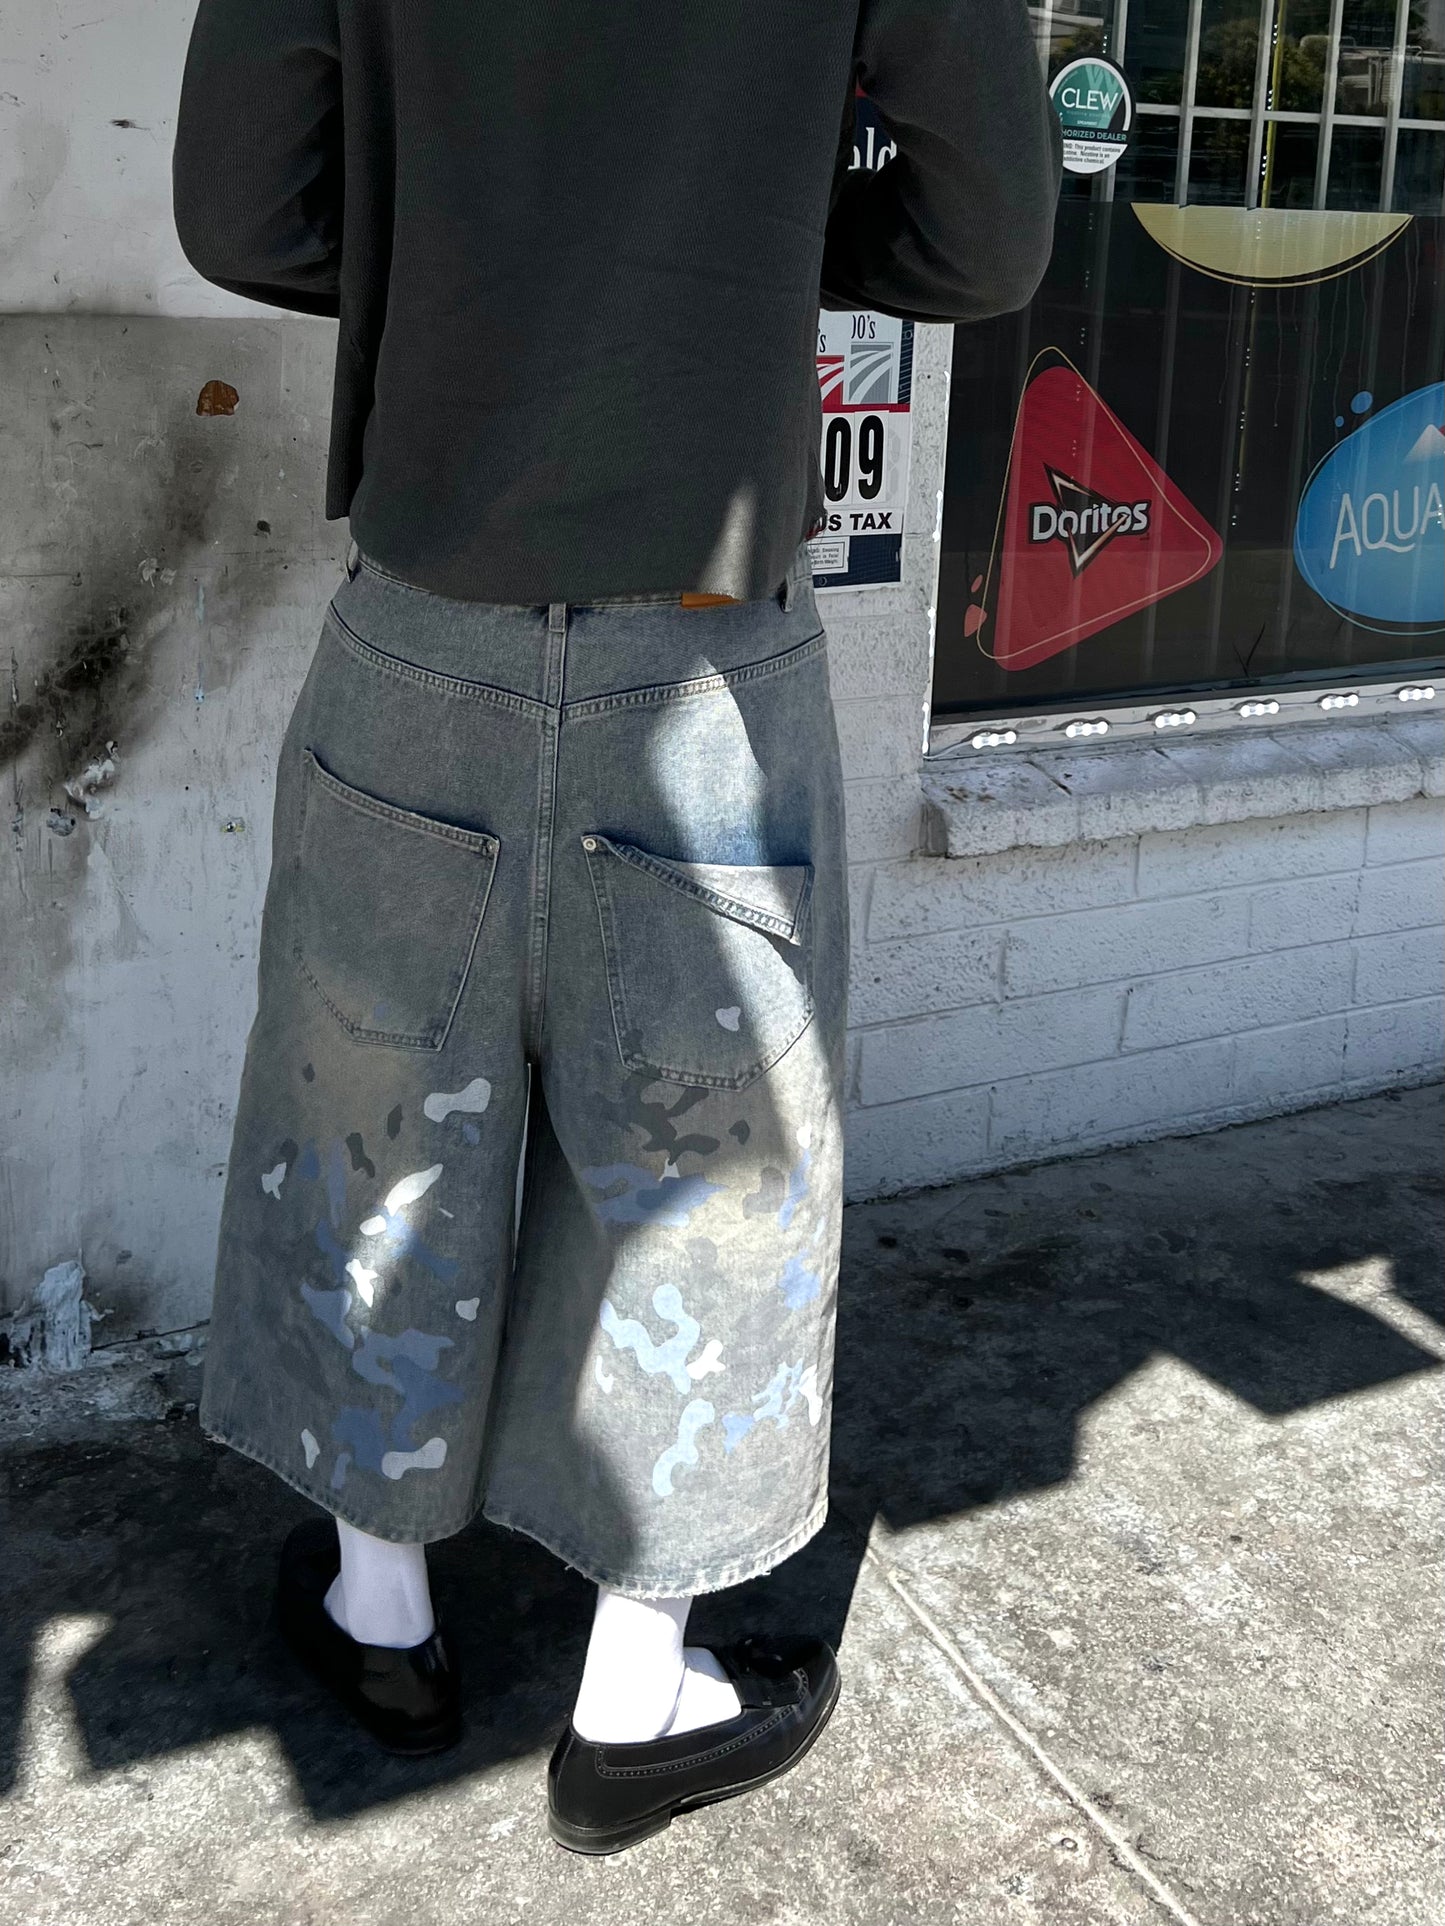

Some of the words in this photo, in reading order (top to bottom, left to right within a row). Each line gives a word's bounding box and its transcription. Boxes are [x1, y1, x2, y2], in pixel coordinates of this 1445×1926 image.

[1061, 88, 1118, 111] CLEW
[1062, 129, 1096, 139] HORIZED
[1097, 132, 1127, 142] DEALER
[825, 414, 884, 502] 09
[849, 512, 893, 531] TAX
[1032, 502, 1148, 541] Doritos
